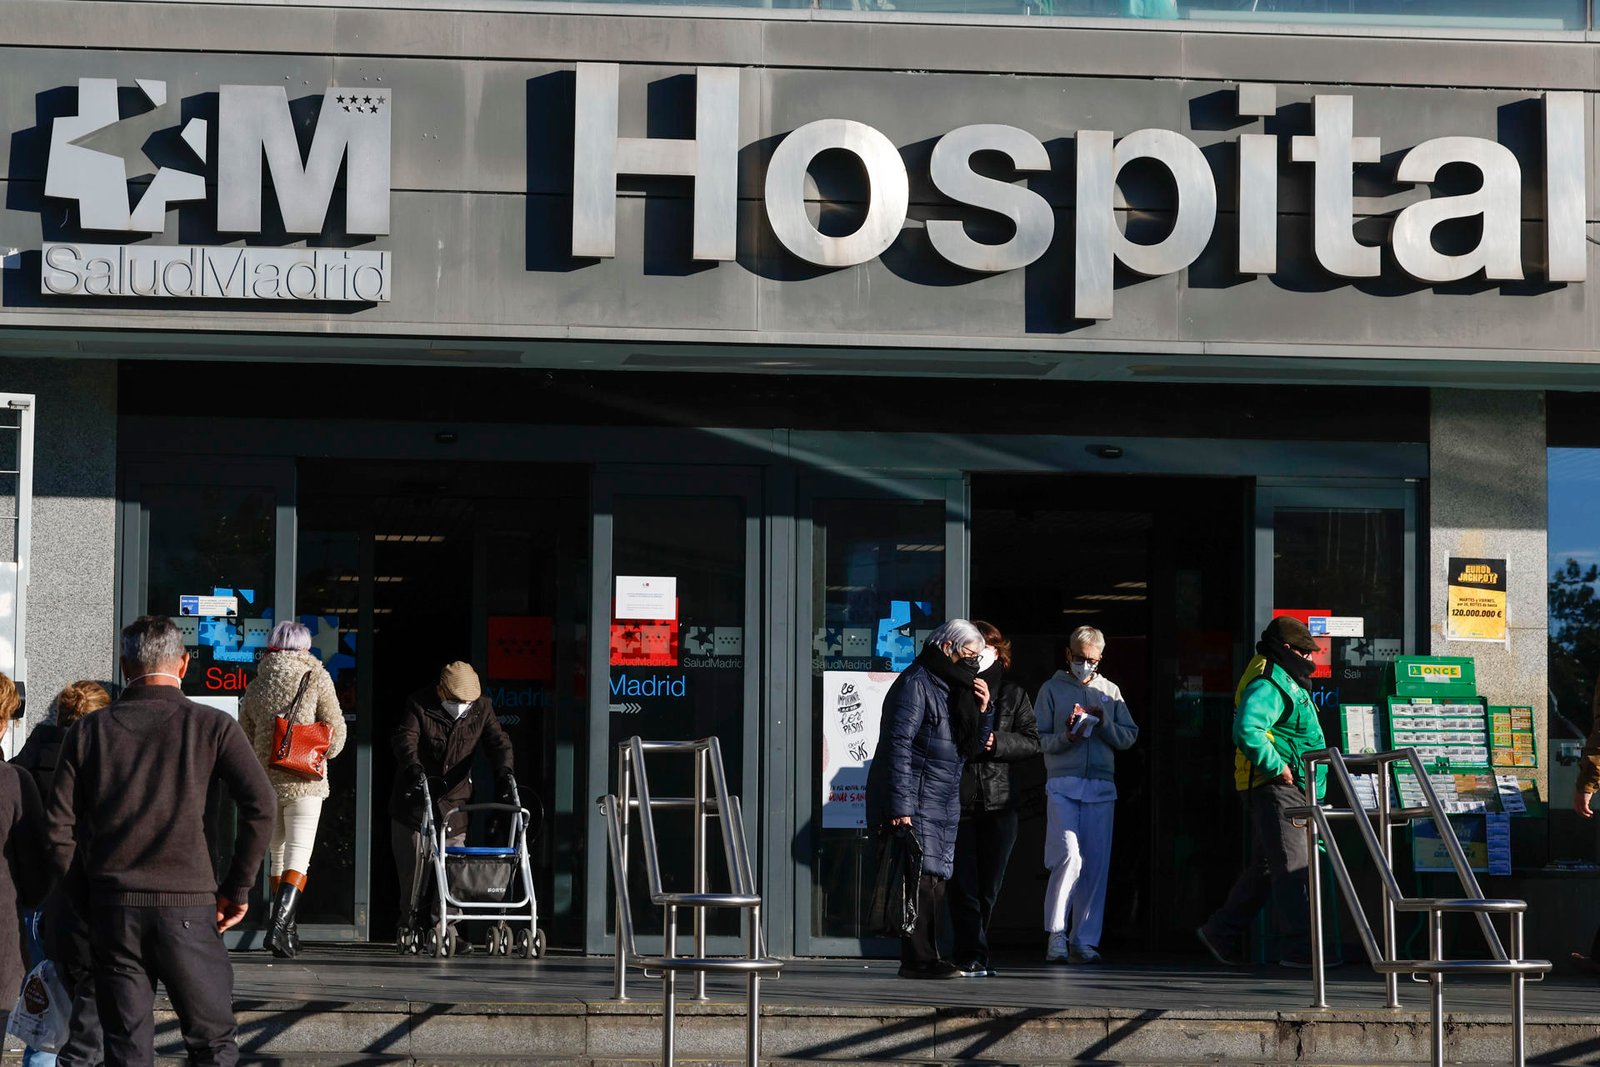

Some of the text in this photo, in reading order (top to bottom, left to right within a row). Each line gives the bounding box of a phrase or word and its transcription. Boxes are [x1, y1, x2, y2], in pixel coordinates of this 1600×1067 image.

[571, 61, 1588, 321] Hospital
[43, 243, 386, 300] SaludMadrid
[1452, 609, 1502, 619] 120.000.000 €
[812, 659, 872, 671] SaludMadrid
[1424, 667, 1458, 675] ONCE
[609, 674, 686, 697] Madrid
[843, 721, 864, 734] PASOS
[849, 742, 868, 761] DAS
[850, 792, 865, 802] SAN
